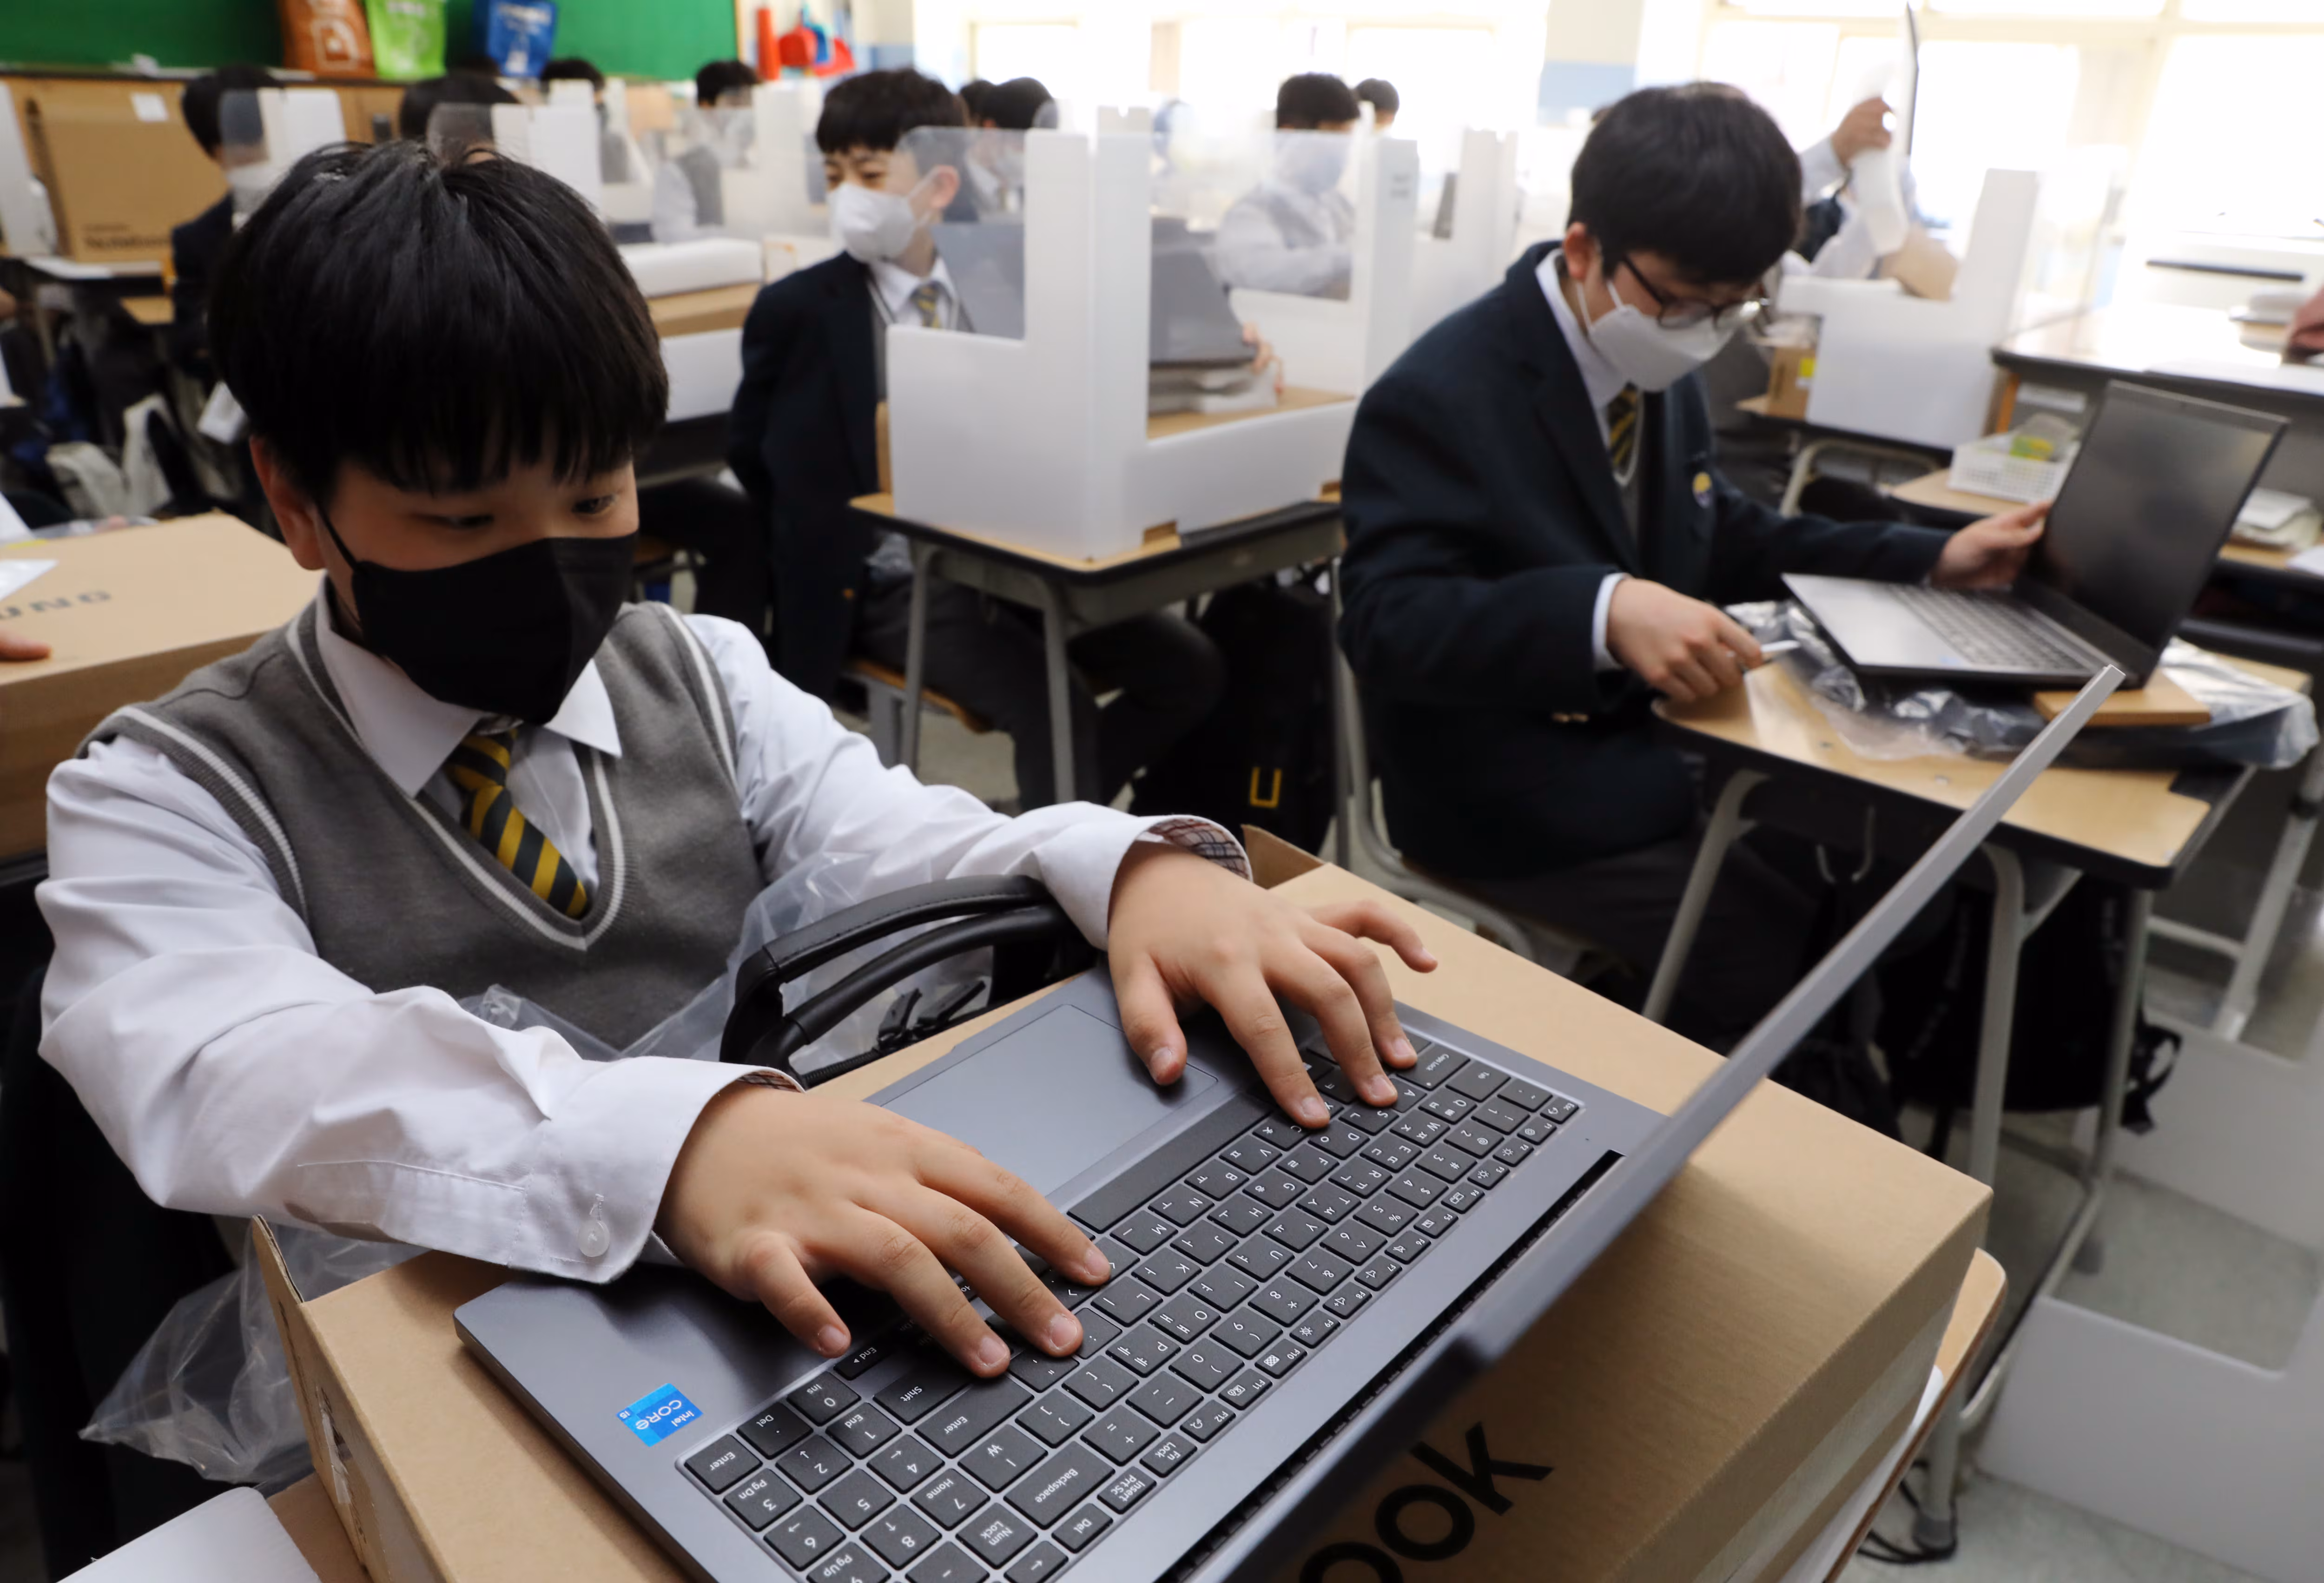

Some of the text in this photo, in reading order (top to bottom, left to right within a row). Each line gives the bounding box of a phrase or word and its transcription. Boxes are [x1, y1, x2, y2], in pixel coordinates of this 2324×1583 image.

[1427, 1122, 1440, 1131] W
[1189, 1198, 1203, 1207] N
[1249, 1208, 1262, 1217] H
[1151, 1224, 1167, 1234] M
[1215, 1236, 1223, 1244] J
[1270, 1251, 1283, 1260] U
[1176, 1263, 1190, 1273] K
[1195, 1311, 1207, 1319] O
[1158, 1341, 1168, 1352] P
[859, 1347, 877, 1360] End
[1287, 1349, 1300, 1359] F10
[807, 1384, 822, 1394] Ins
[1253, 1379, 1265, 1389] F11
[900, 1386, 922, 1401] Shift
[672, 1411, 694, 1426] intel
[756, 1415, 774, 1427] Del
[845, 1414, 864, 1428] End
[1215, 1411, 1228, 1422] F12
[944, 1416, 968, 1434] Enter
[1155, 1442, 1177, 1458] Lock
[1166, 1450, 1181, 1460] Fn
[710, 1452, 735, 1471] Enter
[814, 1463, 828, 1474] 2
[907, 1464, 917, 1473] 4
[926, 1478, 954, 1499] Home
[1035, 1469, 1078, 1503] Backspace
[1119, 1480, 1146, 1502] Insert
[763, 1499, 776, 1510] 3
[858, 1499, 871, 1510] 5
[954, 1498, 965, 1510] 7
[980, 1521, 1004, 1539] Lock
[1074, 1518, 1092, 1534] Del
[902, 1536, 915, 1547] 8
[989, 1527, 1013, 1546] Num
[805, 1537, 816, 1548] 6
